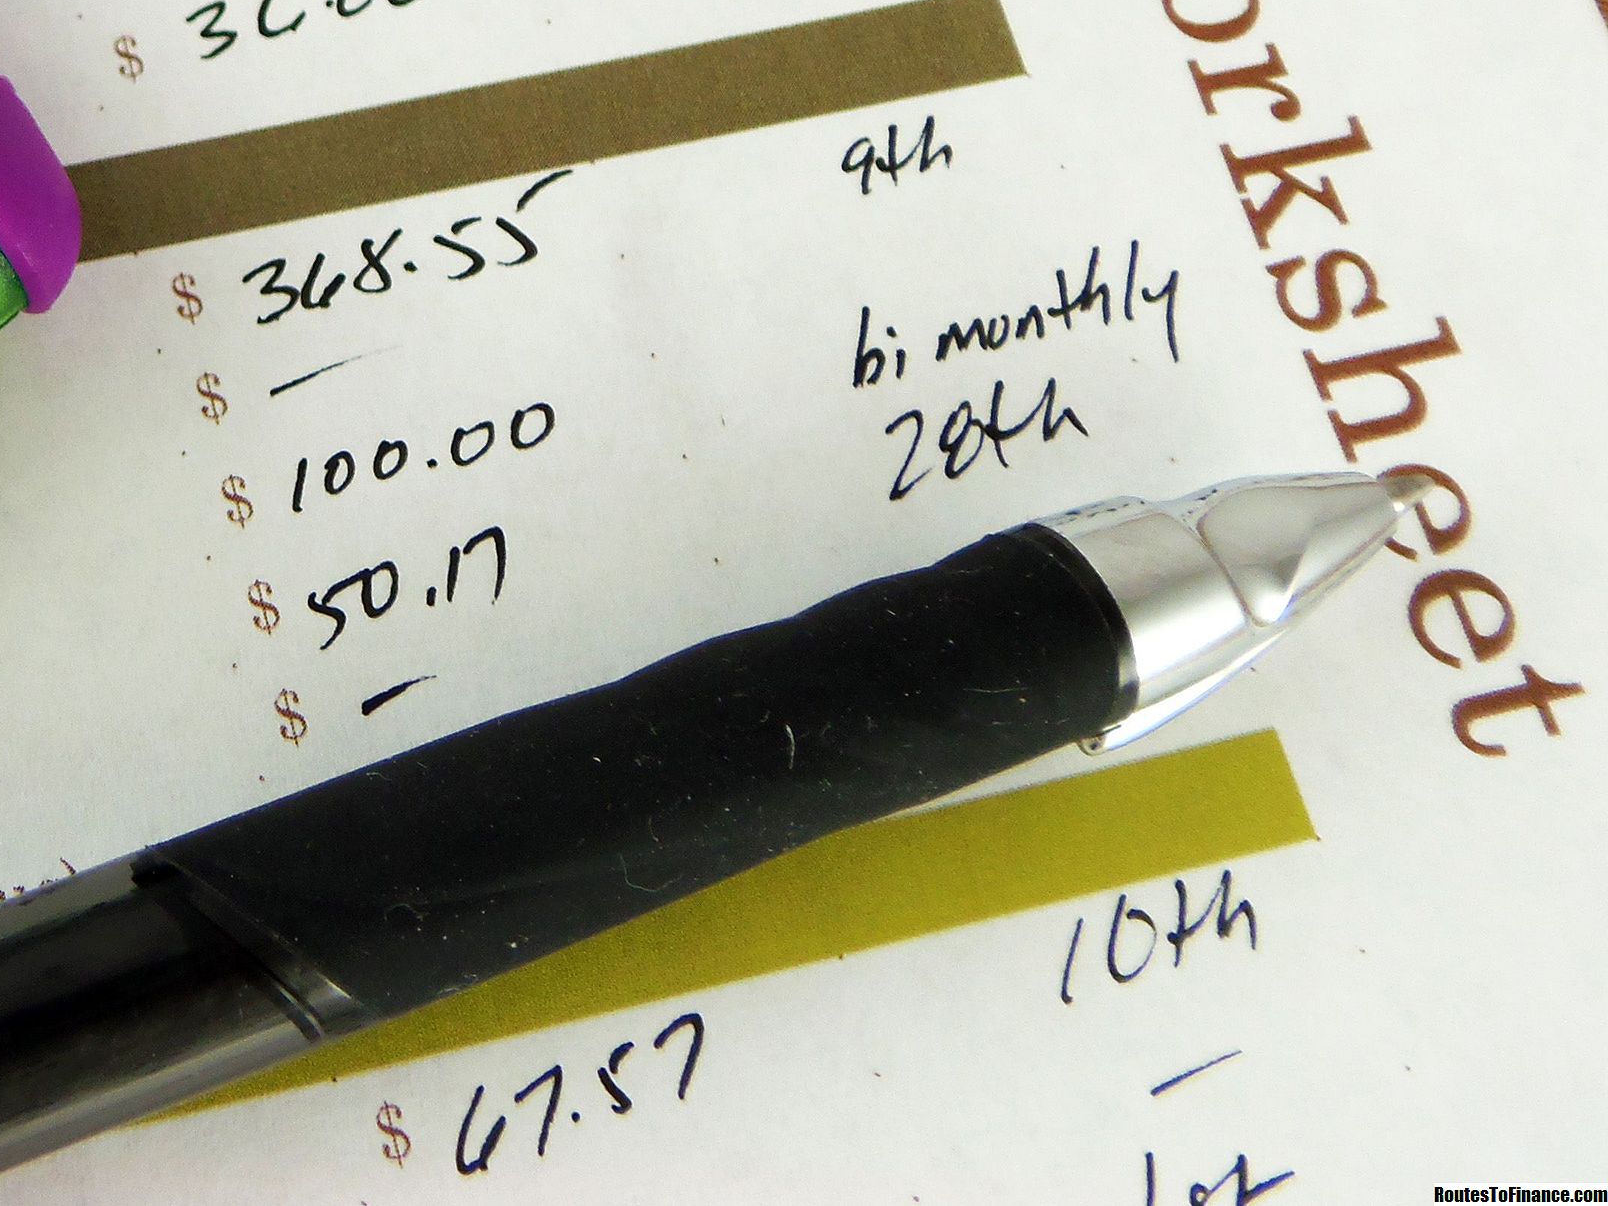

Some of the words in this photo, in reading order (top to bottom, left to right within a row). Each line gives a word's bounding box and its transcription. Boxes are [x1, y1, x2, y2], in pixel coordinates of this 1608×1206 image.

[114, 35, 144, 82] $
[840, 115, 953, 195] 9th
[242, 169, 572, 326] 368.55
[172, 272, 204, 323] $
[853, 306, 907, 389] bi
[937, 238, 1182, 362] monthly
[196, 373, 228, 425] $
[292, 402, 556, 515] 100.00
[885, 377, 1089, 502] 28th
[221, 475, 254, 526] $
[248, 579, 279, 634] $
[307, 526, 507, 651] 50.17
[273, 689, 307, 744] $
[1061, 869, 1259, 1004] 10th
[454, 1011, 705, 1176] 67.57
[376, 1102, 412, 1168] $
